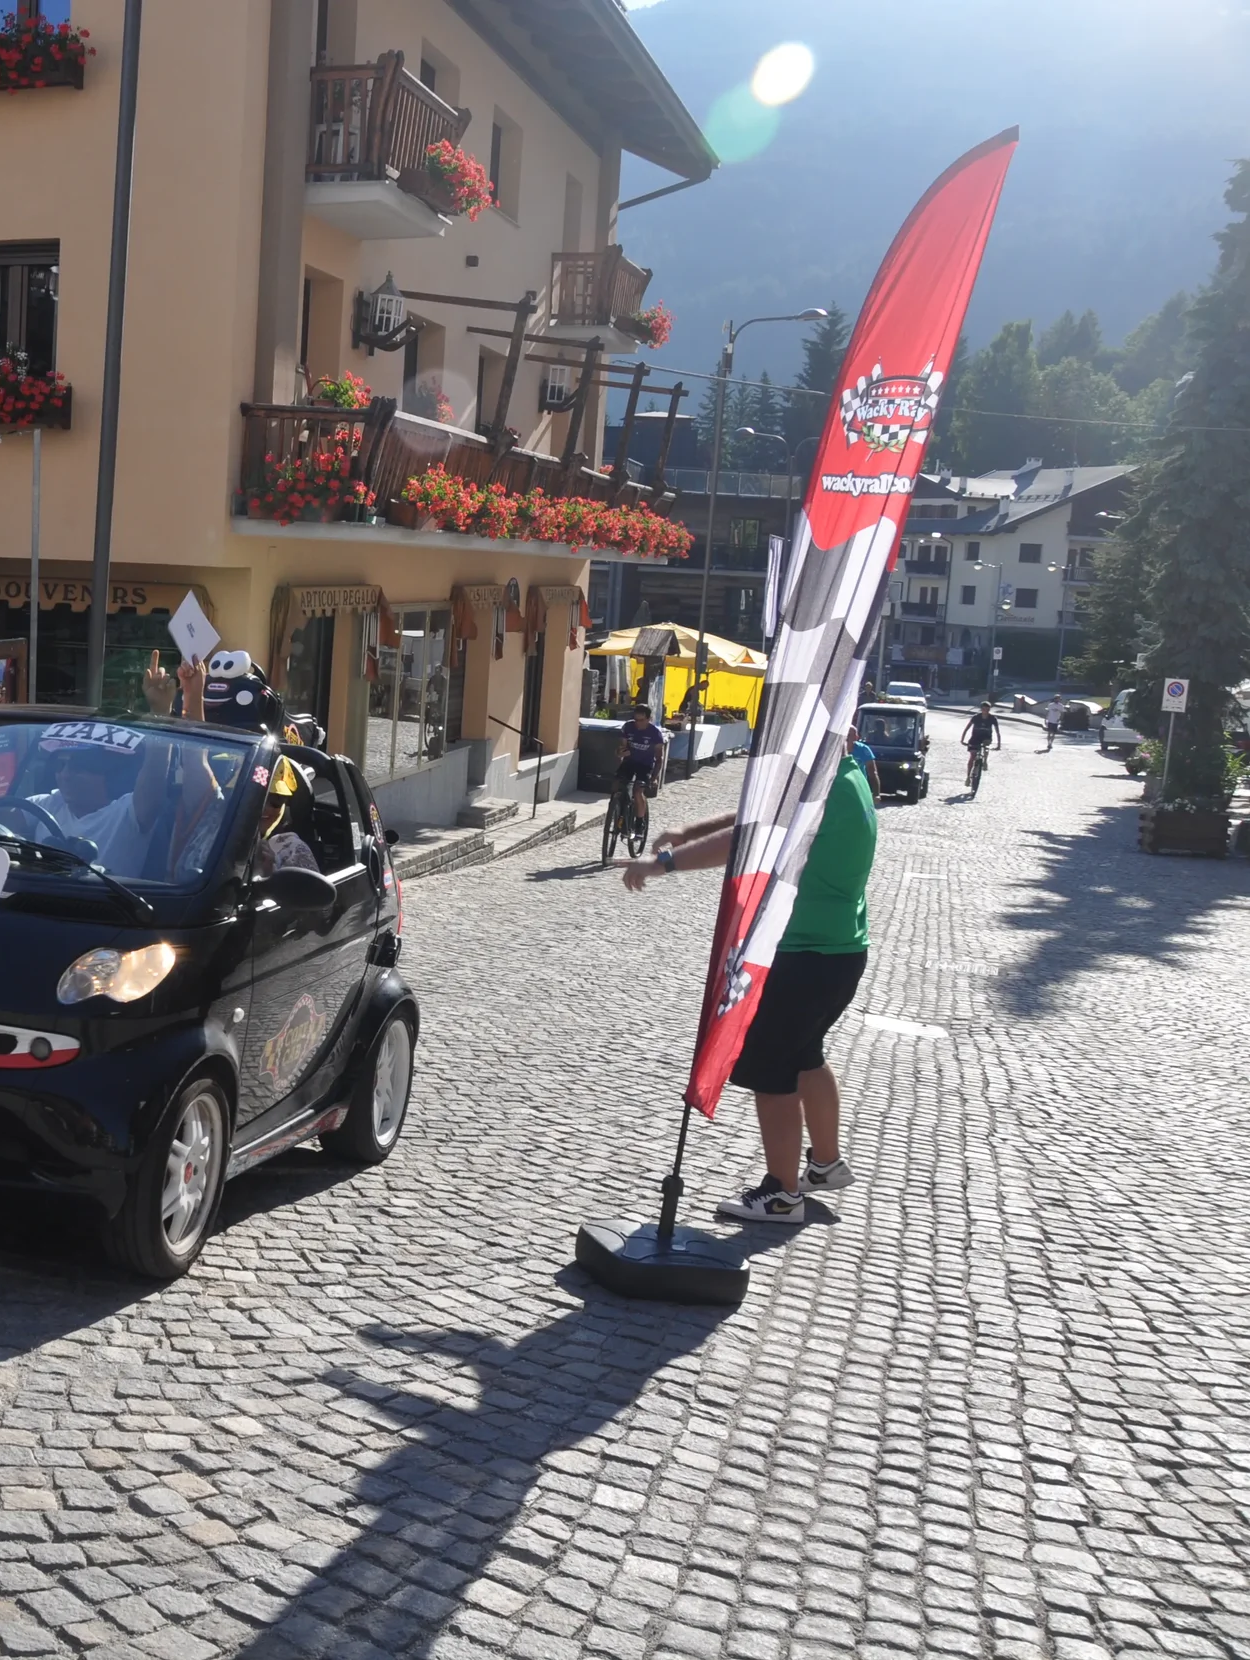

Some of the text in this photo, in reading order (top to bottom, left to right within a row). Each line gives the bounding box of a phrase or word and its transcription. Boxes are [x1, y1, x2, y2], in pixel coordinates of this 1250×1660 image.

[856, 400, 896, 421] Wacky
[300, 589, 377, 608] ARTICOLI REGALO
[47, 723, 140, 749] TAXI
